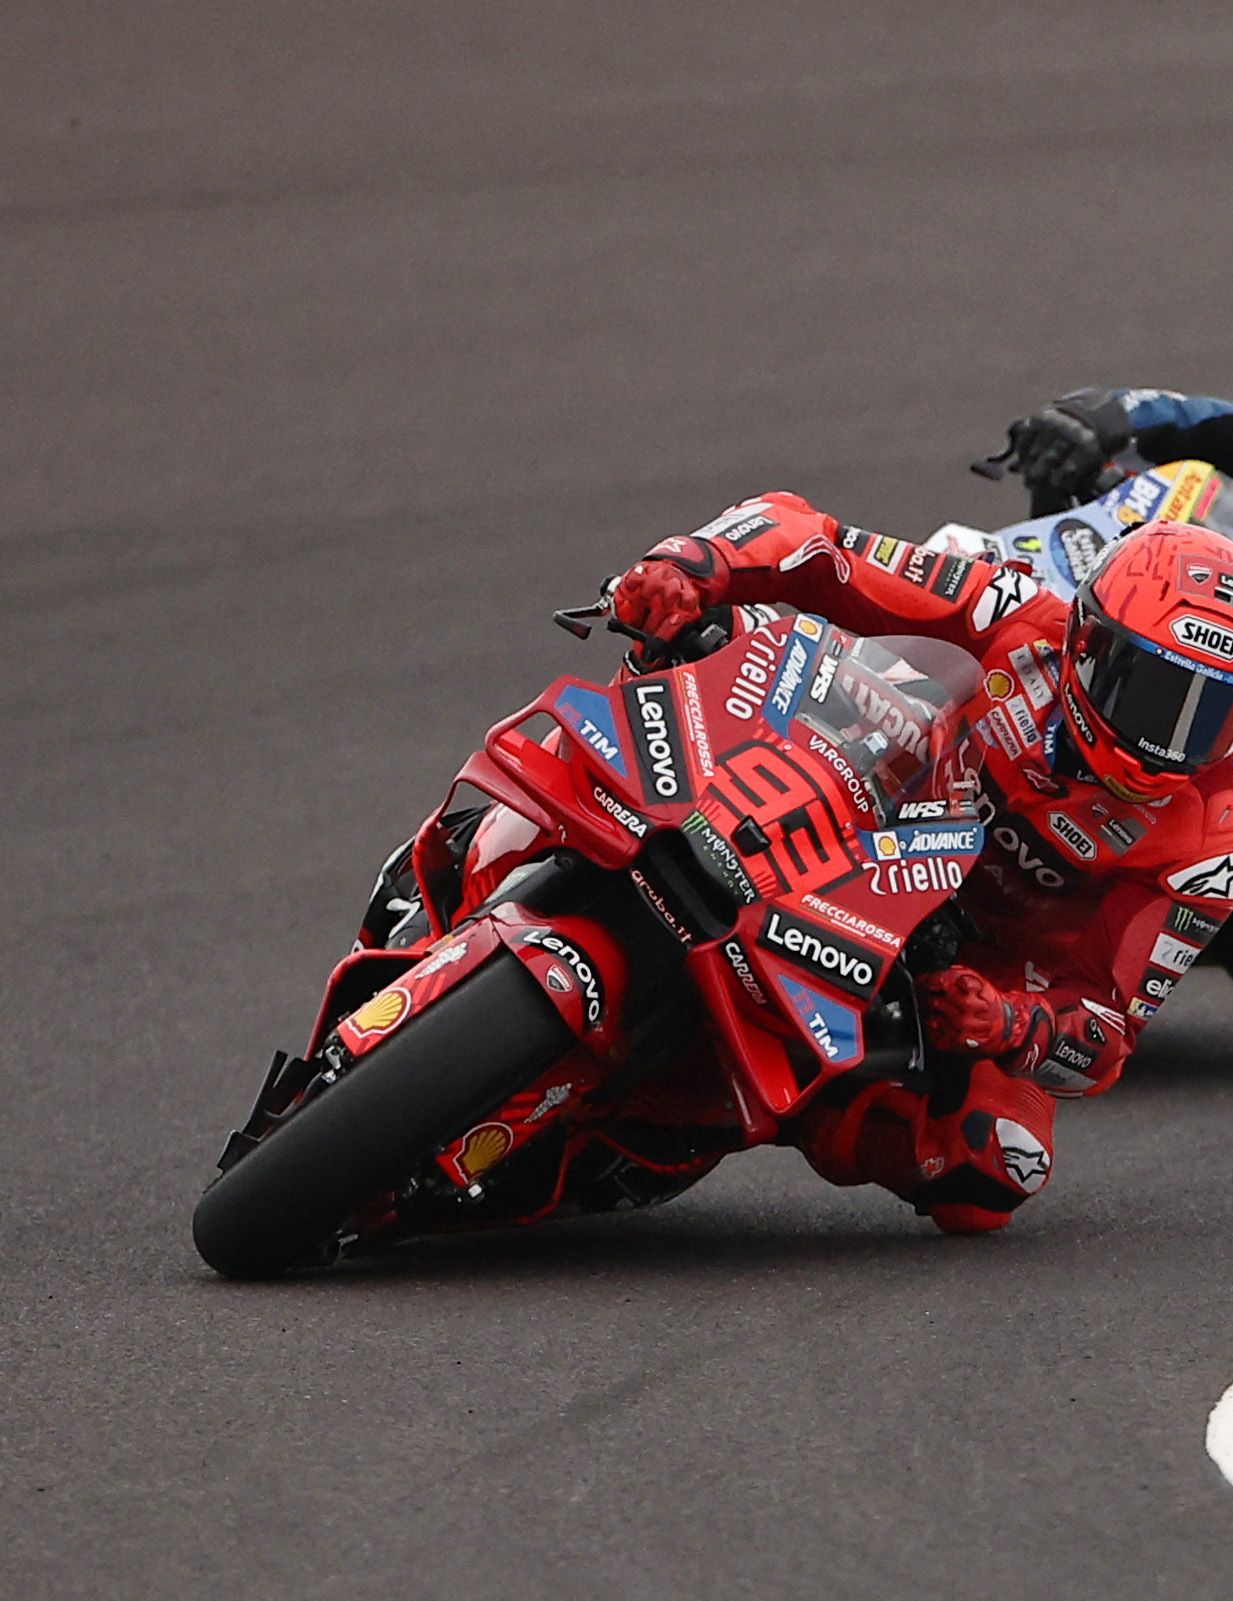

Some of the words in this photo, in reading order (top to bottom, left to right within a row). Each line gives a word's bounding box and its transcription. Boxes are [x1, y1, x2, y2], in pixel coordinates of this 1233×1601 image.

[725, 516, 774, 541] Lenovo
[726, 640, 777, 720] riello
[772, 638, 808, 715] ADVANCE
[810, 654, 839, 703] WRS
[683, 672, 715, 777] FRECCIAROSSA
[1015, 709, 1038, 743] riello
[1045, 724, 1056, 754] TIM
[1065, 683, 1093, 743] Lenovo
[580, 720, 618, 760] TIM
[636, 685, 678, 796] Lenovo
[1138, 737, 1186, 763] Insta360
[809, 735, 869, 814] VARGROUP
[593, 787, 648, 838] CARRERA
[711, 746, 853, 893] 93
[899, 801, 946, 819] WRS
[1053, 817, 1092, 855] SHOEI
[702, 828, 756, 904] MONSTER
[909, 831, 974, 852] ADVANCE
[888, 857, 963, 894] riello
[631, 869, 693, 943] aruba.it
[801, 894, 901, 948] FRECCIAROSSA
[523, 931, 600, 1021] Lenovo
[725, 942, 767, 1004] CARRERA
[767, 914, 873, 986] Lenovo
[809, 1013, 839, 1058] TIM
[1055, 1040, 1092, 1068] Lenovo
